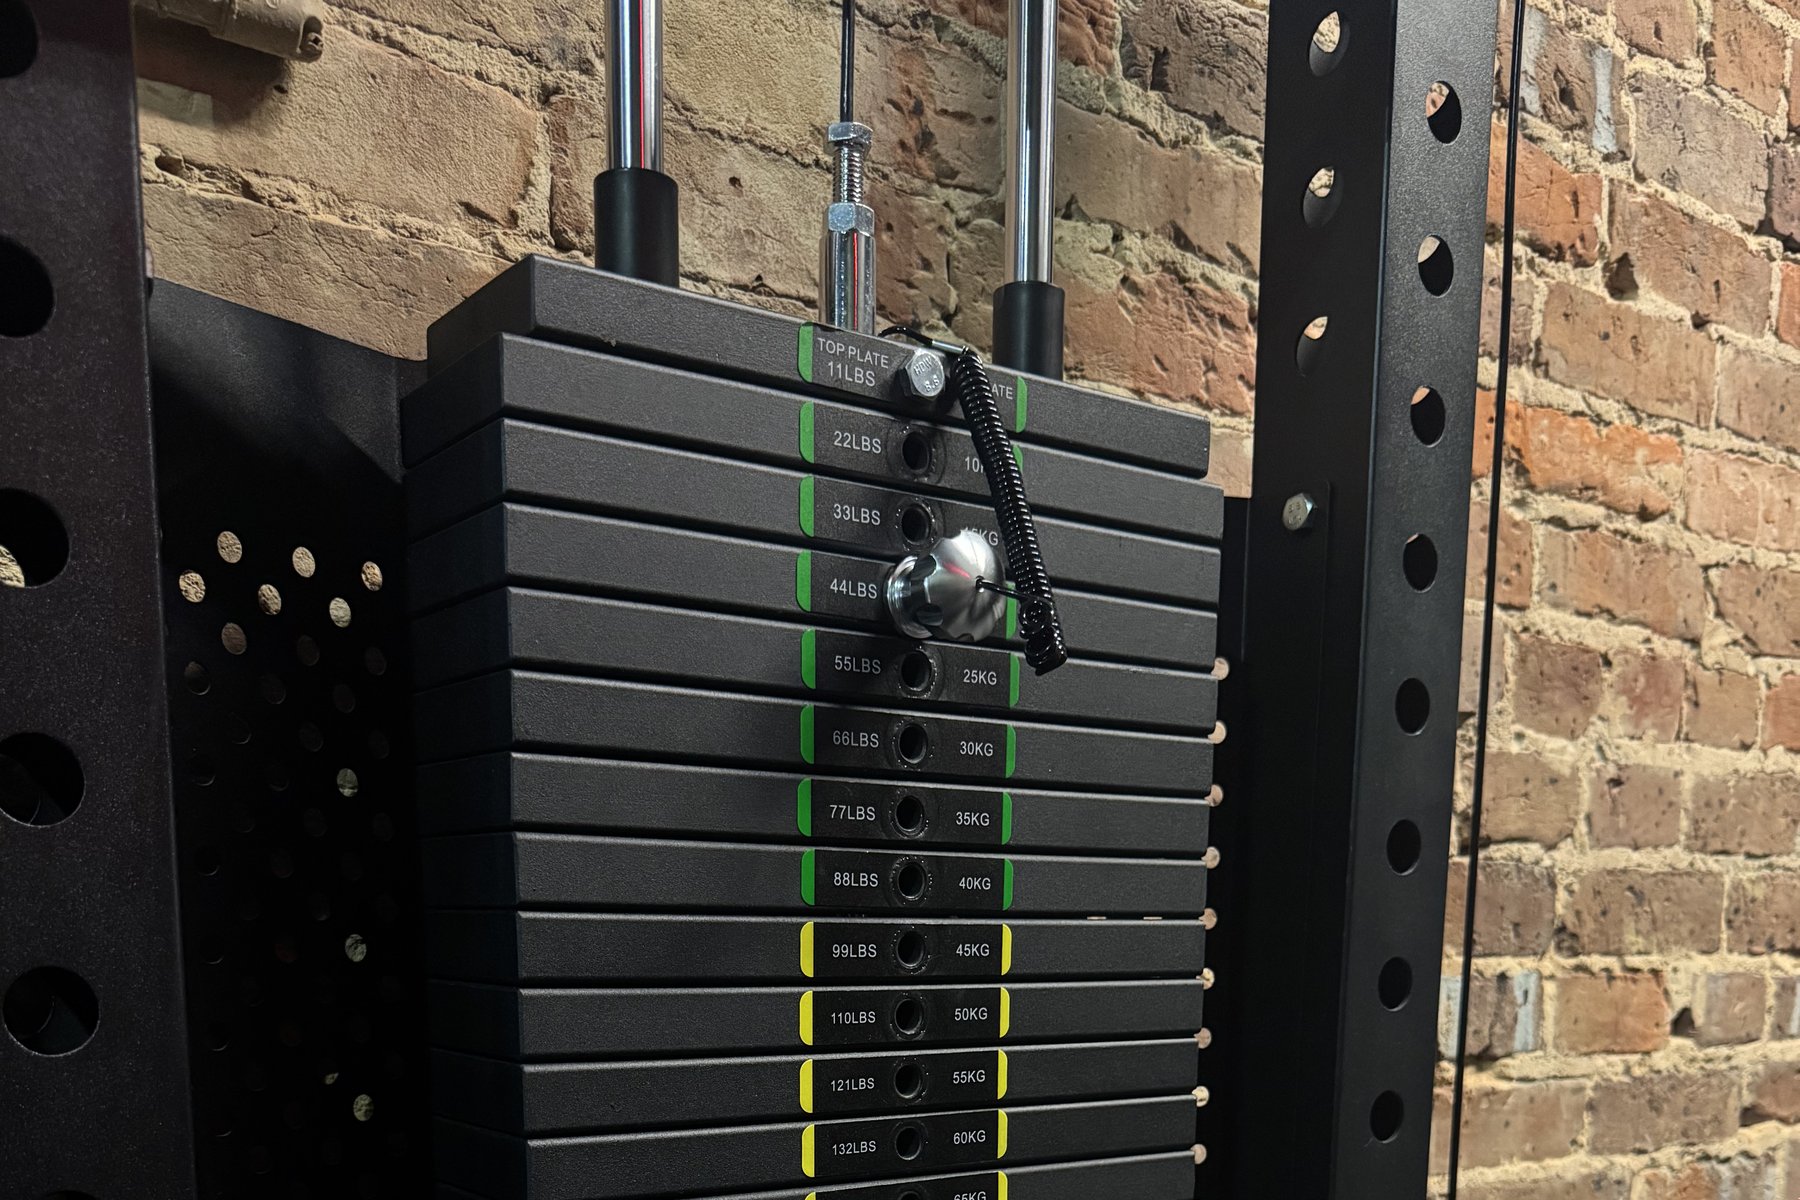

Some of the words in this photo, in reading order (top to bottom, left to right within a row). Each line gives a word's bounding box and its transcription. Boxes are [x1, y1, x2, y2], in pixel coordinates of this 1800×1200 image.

[818, 337, 845, 355] TOP
[848, 345, 889, 369] PLATE
[827, 361, 877, 387] 11LBS
[992, 383, 1013, 400] ATE
[833, 430, 882, 454] 22LBS
[833, 503, 881, 526] 33LBS
[829, 577, 878, 599] 44LBS
[834, 655, 881, 674] 55LBS
[963, 668, 997, 686] 25KG
[833, 730, 879, 748] 66LBS
[959, 740, 994, 757] 30KG
[829, 804, 876, 821] 77LBS
[955, 811, 990, 827] 35KG
[833, 871, 879, 888] 88LBS
[958, 877, 991, 890] 40KG
[832, 943, 877, 958] 99LBS
[955, 943, 990, 957] 45KG
[831, 1010, 876, 1025] 110LBS
[954, 1007, 988, 1021] 50KG
[830, 1077, 875, 1092] 121LBS
[952, 1069, 986, 1084] 55KG
[953, 1129, 986, 1145] 60KG
[832, 1140, 877, 1156] 132LBS
